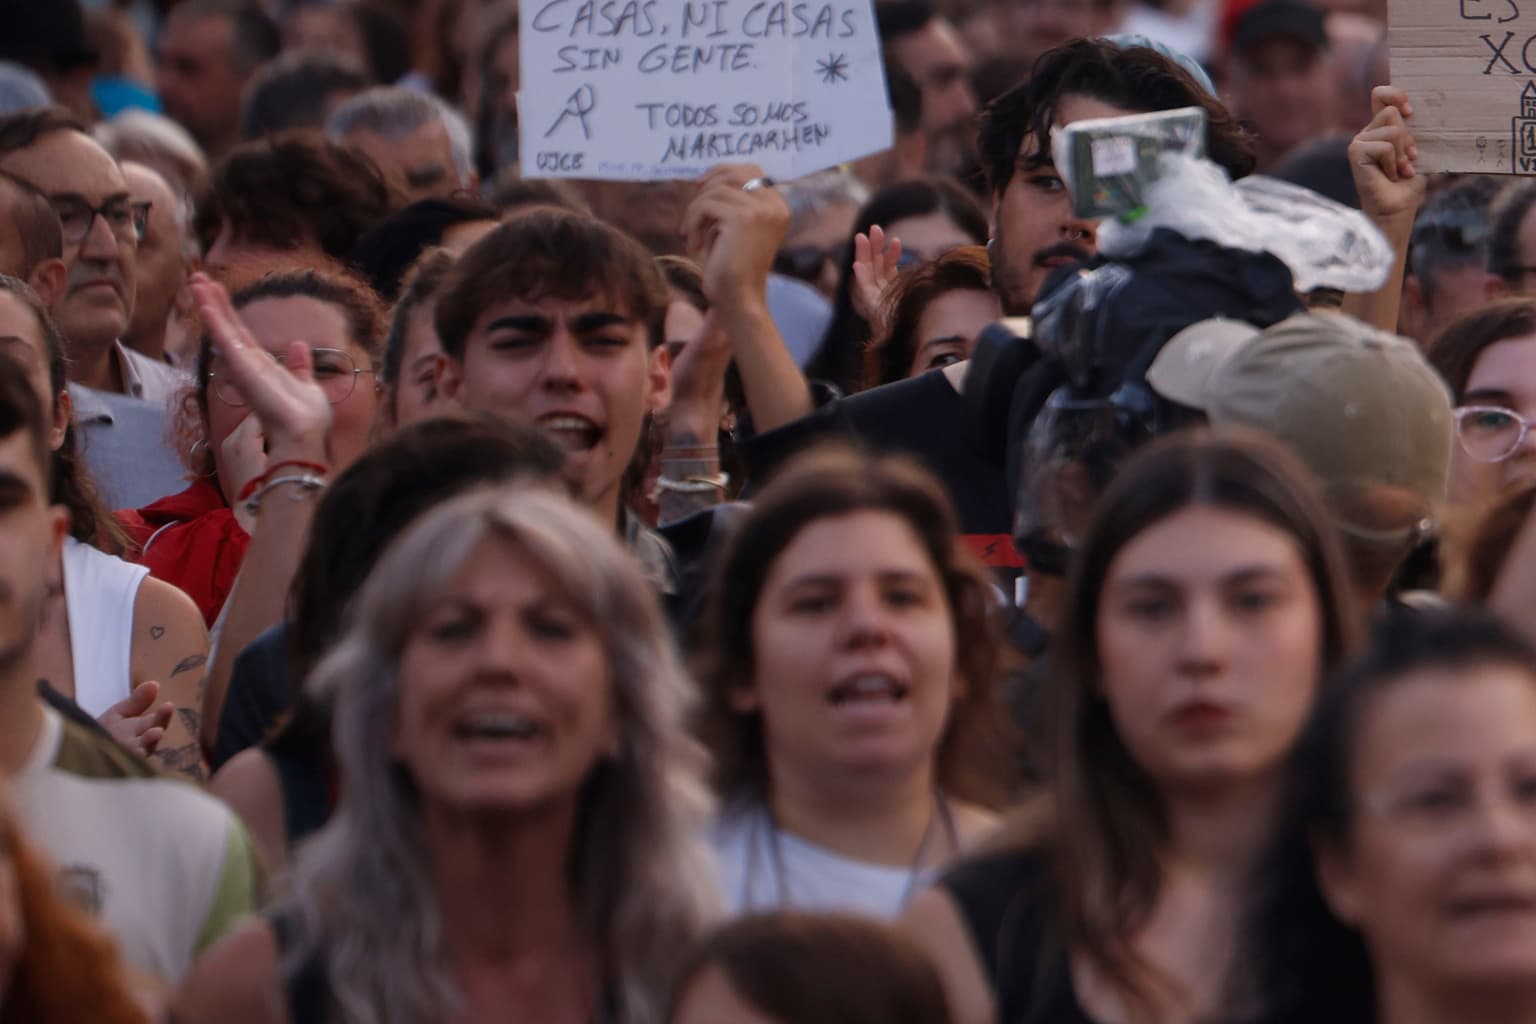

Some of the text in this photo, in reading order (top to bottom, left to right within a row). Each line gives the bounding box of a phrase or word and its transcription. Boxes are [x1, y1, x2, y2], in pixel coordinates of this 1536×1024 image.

[681, 0, 729, 38] NI
[741, 0, 857, 39] CASAS
[552, 45, 623, 74] SIN
[635, 101, 809, 130] TODOS SOMOS
